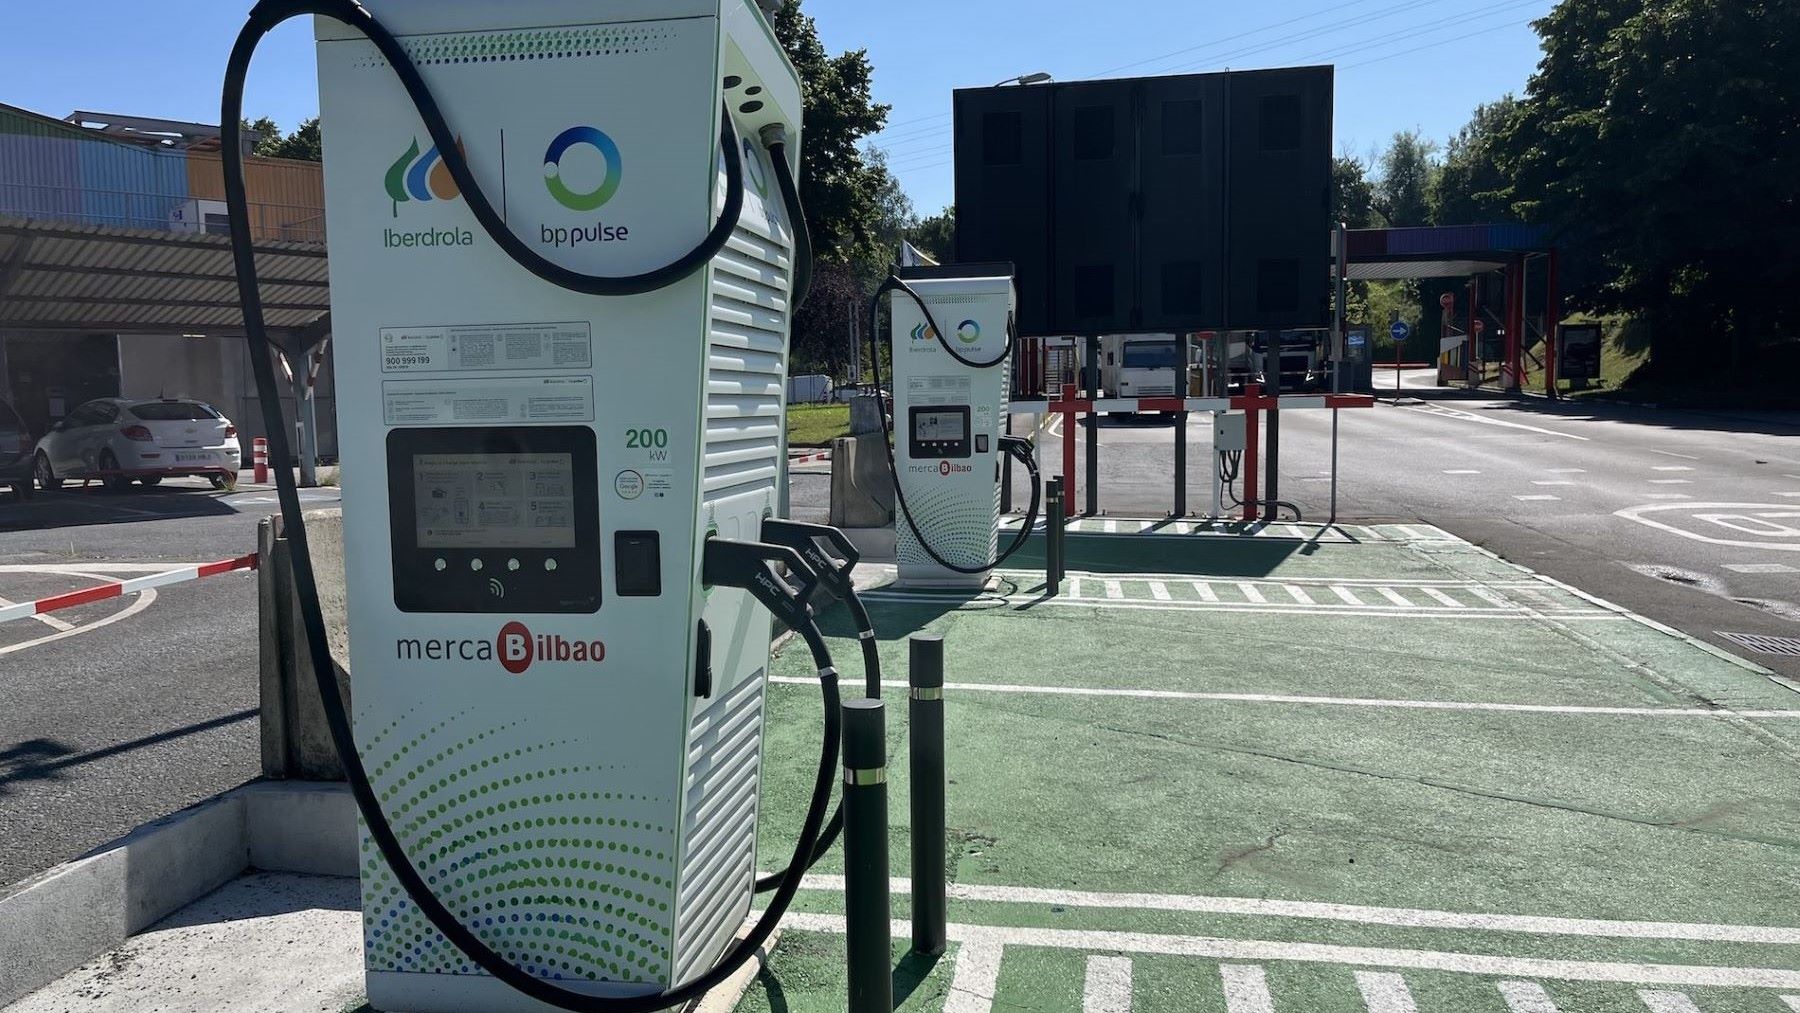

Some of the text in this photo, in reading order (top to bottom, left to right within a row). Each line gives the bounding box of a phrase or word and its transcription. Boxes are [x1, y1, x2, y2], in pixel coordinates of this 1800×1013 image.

[383, 226, 473, 248] Iberdrola
[385, 356, 400, 366] 900
[401, 356, 416, 365] 999
[625, 428, 668, 448] 200
[649, 450, 668, 461] kW
[805, 548, 827, 569] HPC
[755, 571, 780, 597] HPC
[396, 630, 606, 665] mercaBilbao
